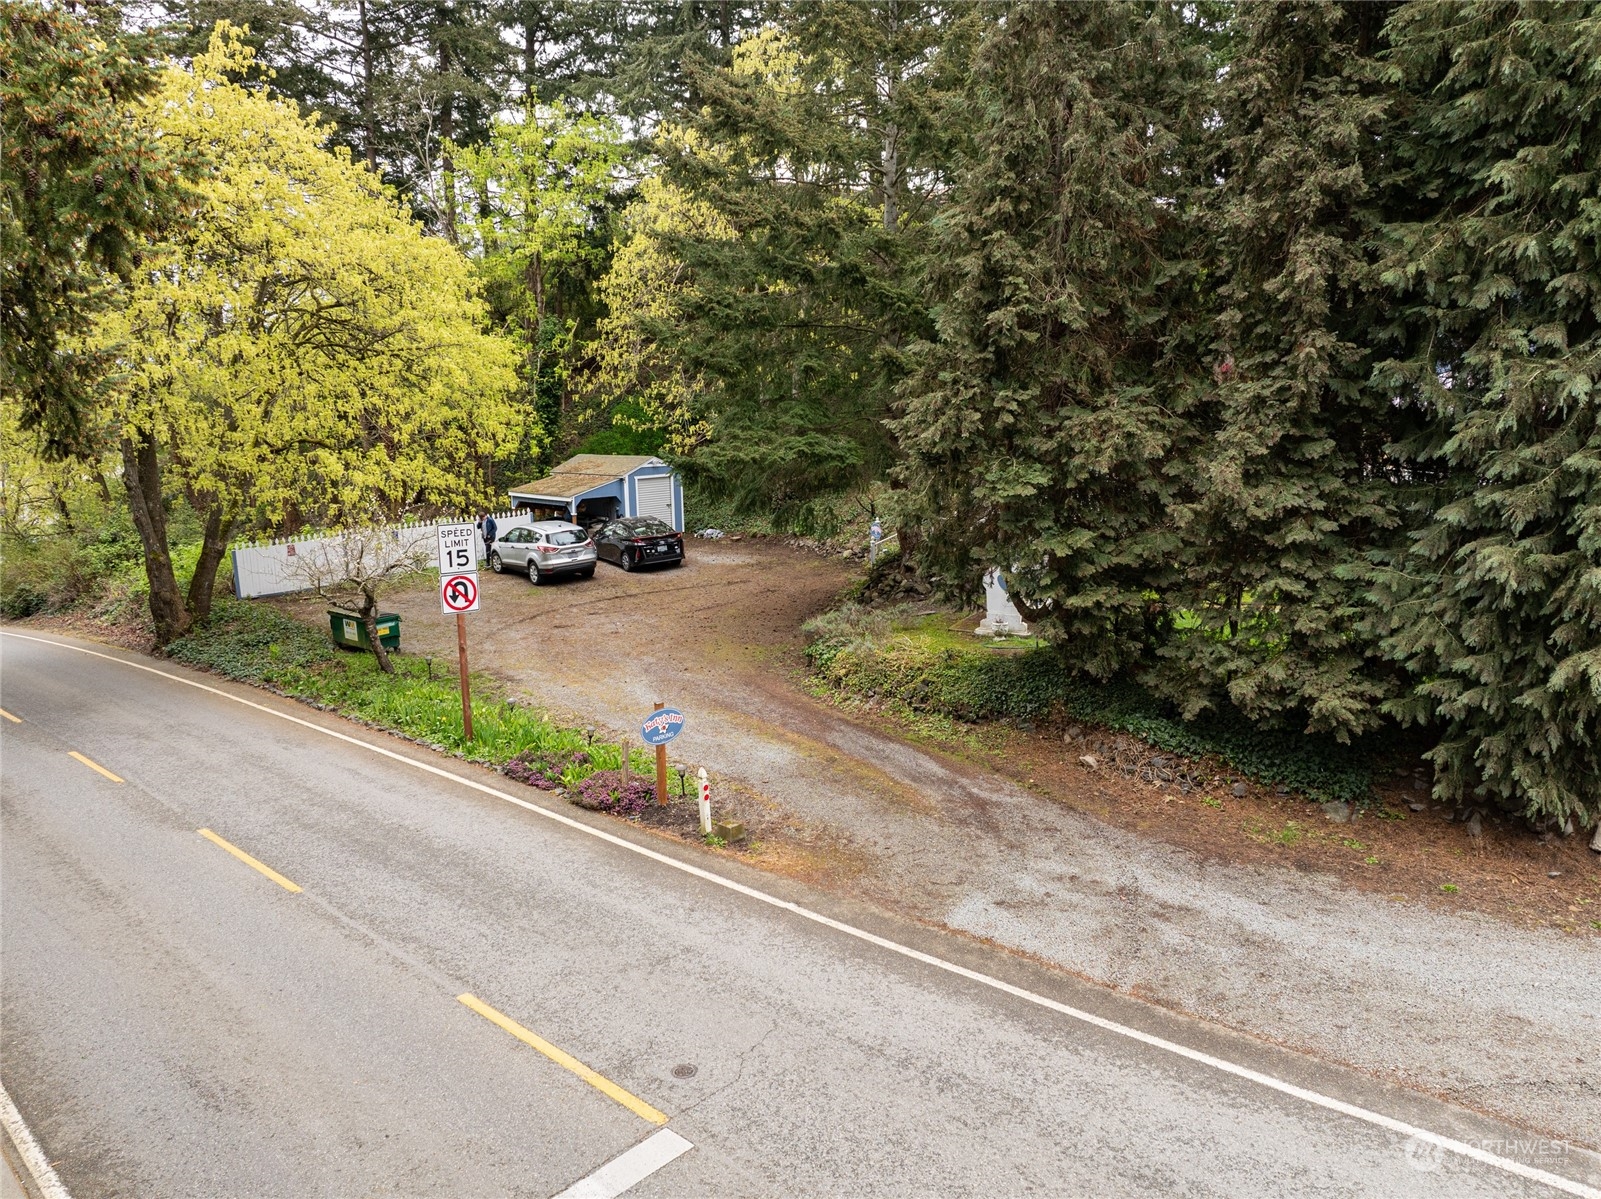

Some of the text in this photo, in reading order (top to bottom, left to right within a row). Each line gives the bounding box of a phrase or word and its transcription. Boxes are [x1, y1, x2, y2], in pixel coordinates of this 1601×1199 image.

[440, 529, 472, 538] SPEED
[445, 539, 469, 548] LIMIT
[446, 549, 469, 567] 15
[669, 713, 683, 724] Inn
[652, 731, 674, 742] PARKING
